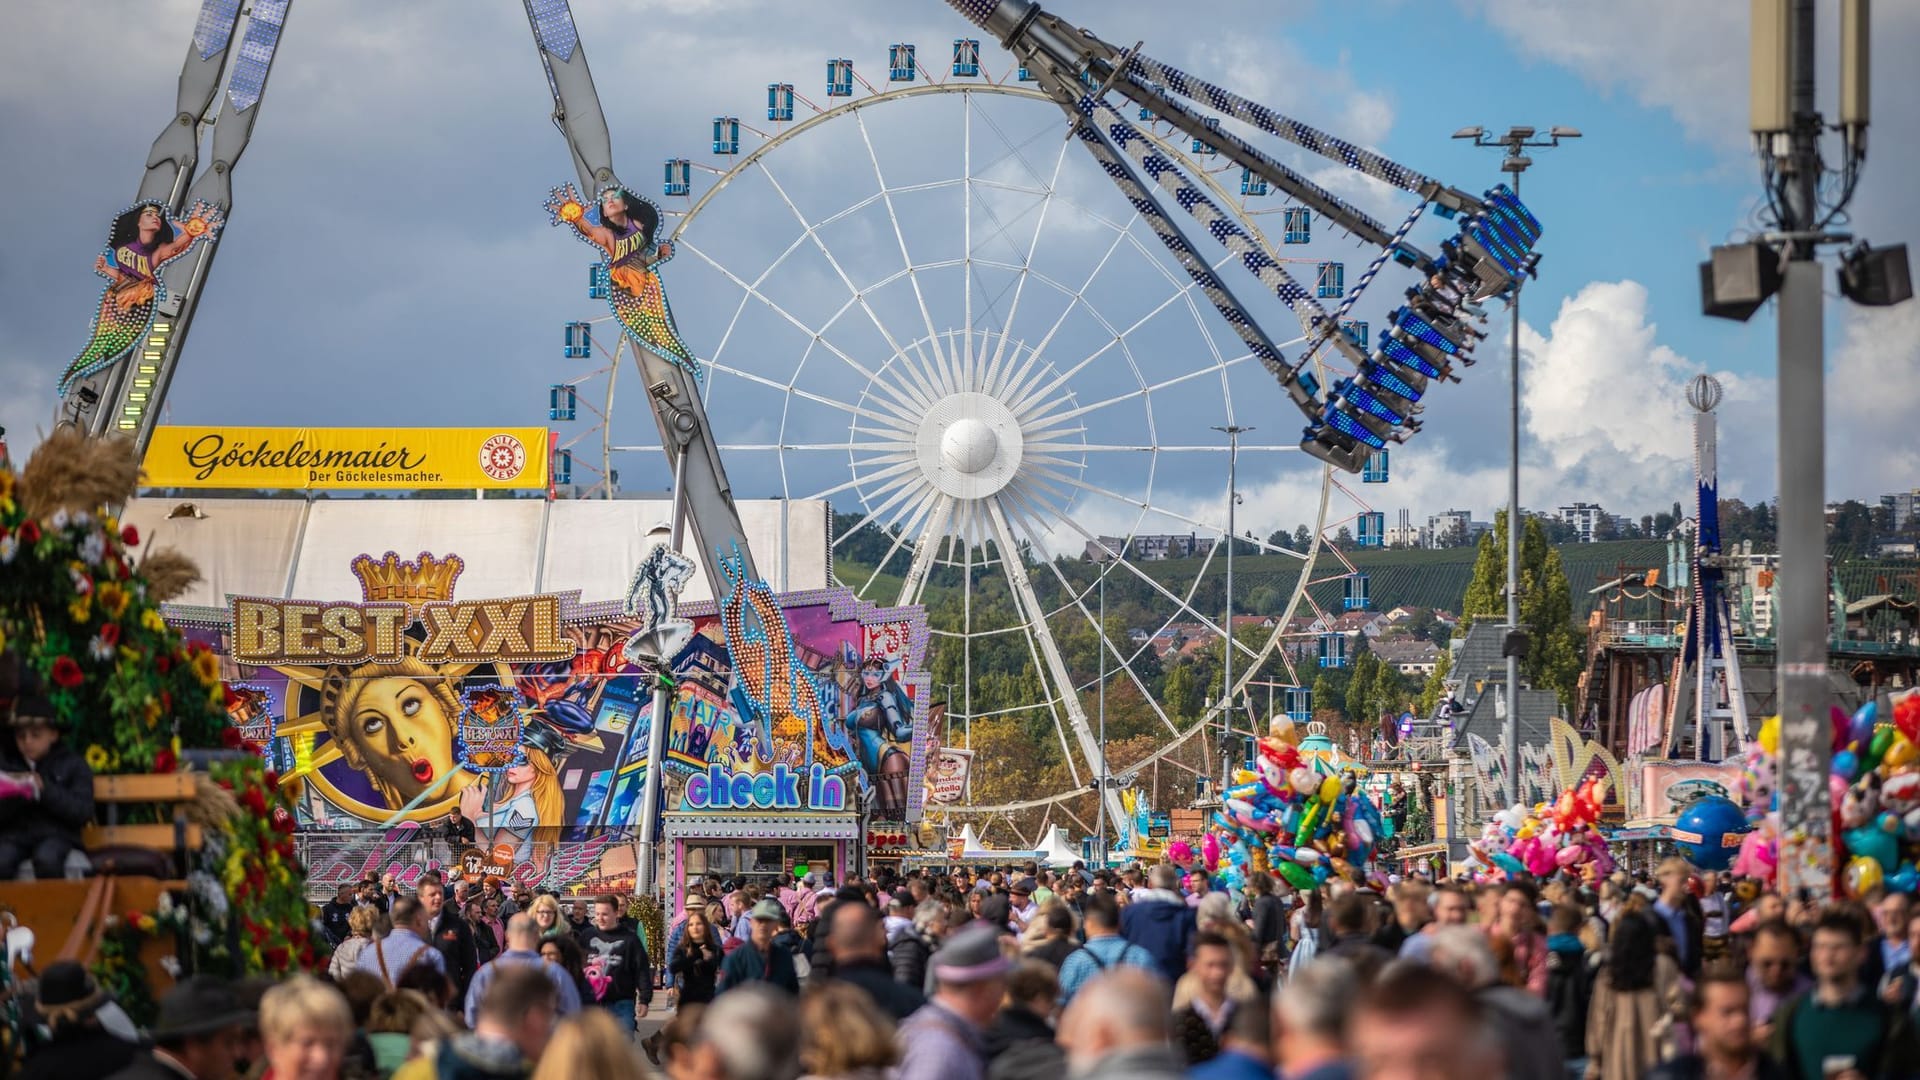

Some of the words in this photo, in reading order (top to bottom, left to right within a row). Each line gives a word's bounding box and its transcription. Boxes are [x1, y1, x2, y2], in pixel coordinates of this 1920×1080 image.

[484, 436, 521, 451] WULLE
[184, 434, 426, 480] Göckelesmaier
[309, 471, 331, 482] Der
[336, 470, 443, 482] Göckelesmacher.
[484, 464, 520, 479] BIERE
[372, 585, 438, 599] THE
[239, 602, 404, 657] BEST
[429, 599, 573, 655] XXL
[675, 694, 732, 737] HAIR
[685, 763, 801, 809] check
[808, 763, 846, 811] in
[935, 785, 961, 793] utella
[867, 832, 907, 847] êpes
